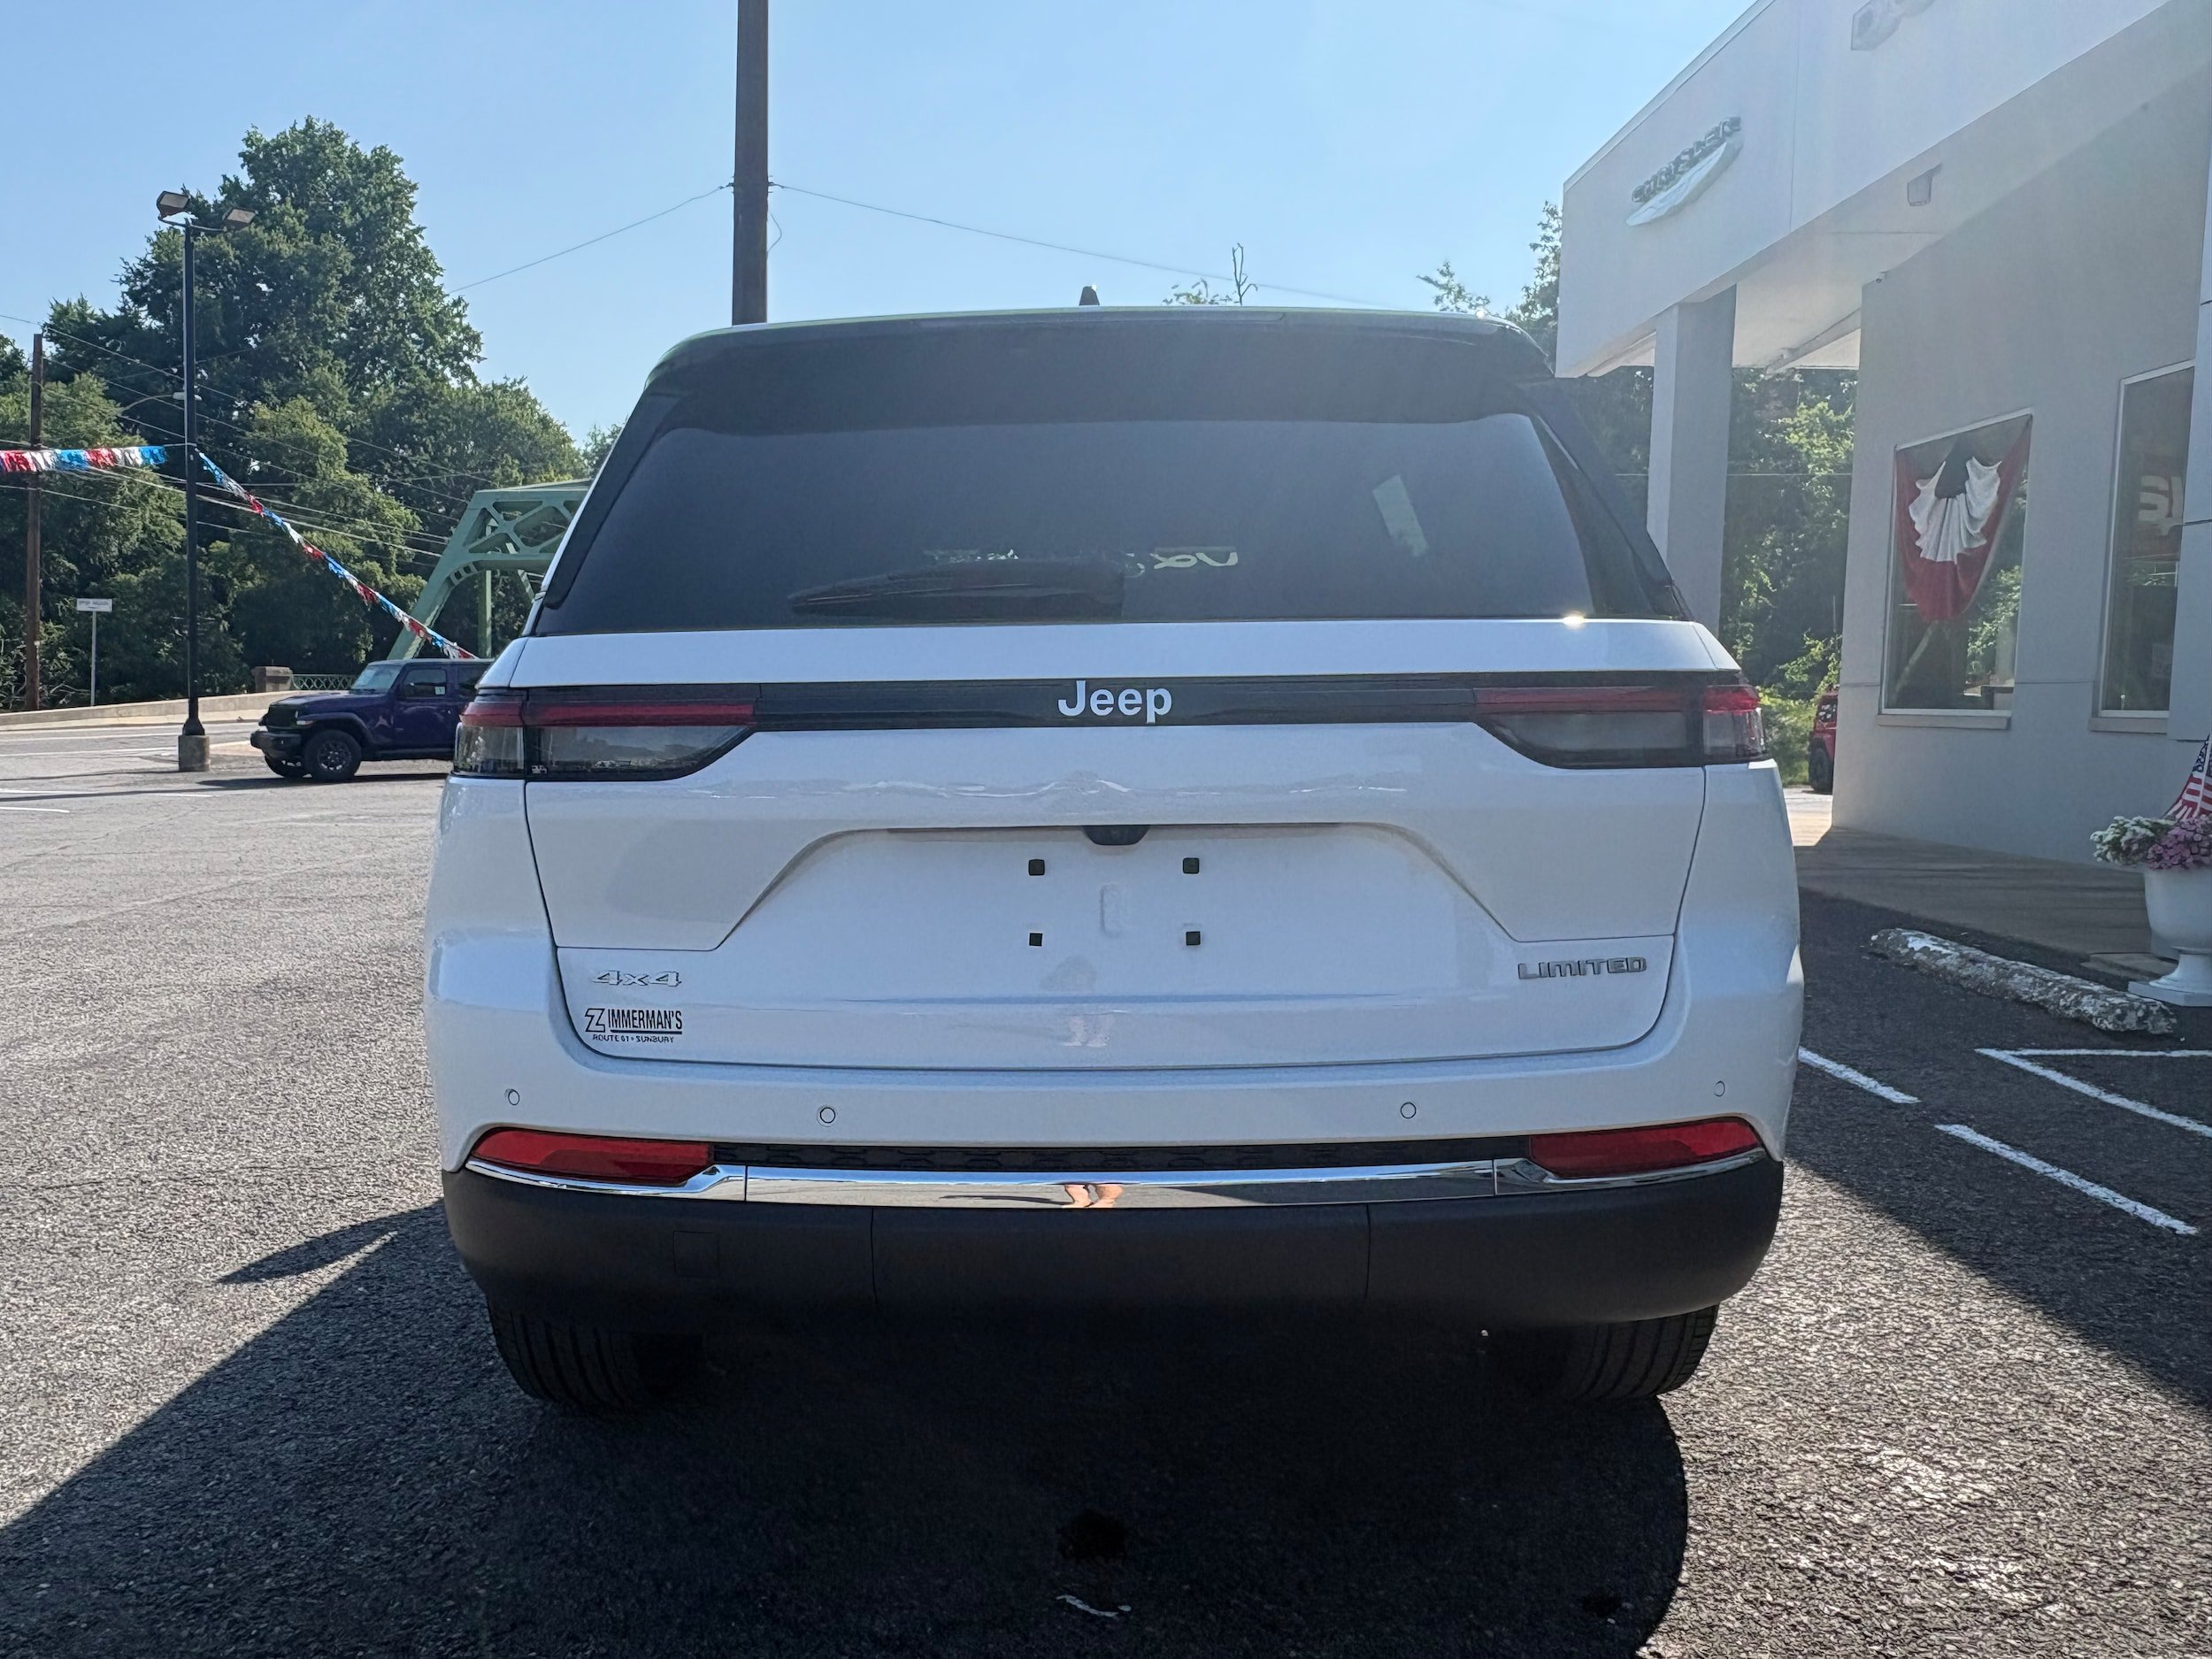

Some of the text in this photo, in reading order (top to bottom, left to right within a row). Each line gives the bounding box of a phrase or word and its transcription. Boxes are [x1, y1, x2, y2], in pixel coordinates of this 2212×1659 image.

[1057, 680, 1172, 724] Jeep
[592, 970, 682, 987] 4x4
[1517, 956, 1647, 979] LIMITED
[585, 1008, 683, 1033] ZIMMERMAN'S
[592, 1033, 619, 1042] ROUTE
[635, 1035, 675, 1044] SUNBURY
